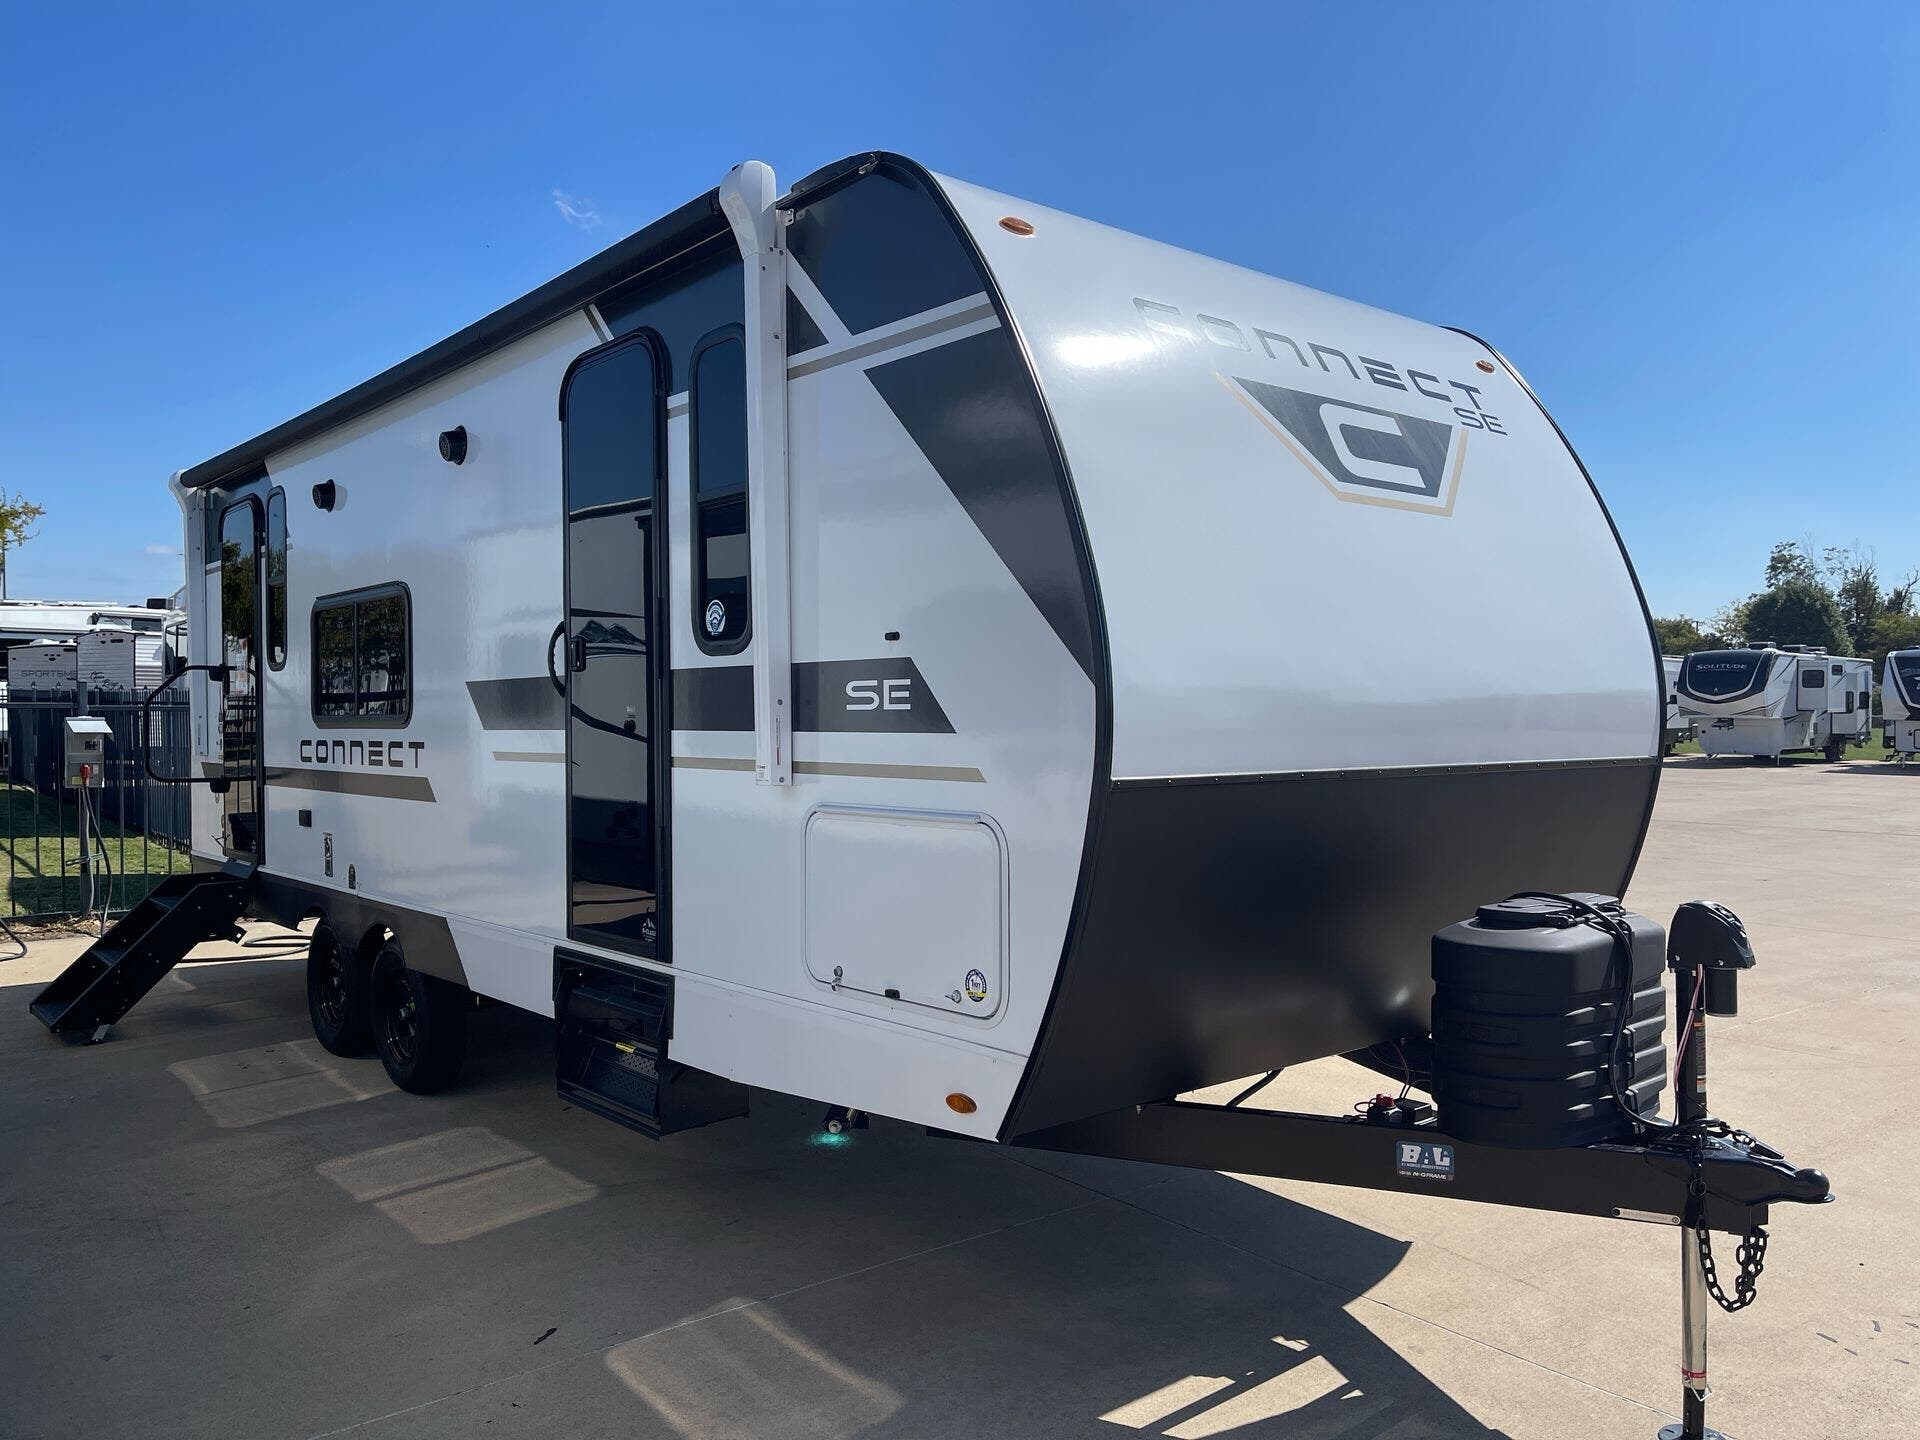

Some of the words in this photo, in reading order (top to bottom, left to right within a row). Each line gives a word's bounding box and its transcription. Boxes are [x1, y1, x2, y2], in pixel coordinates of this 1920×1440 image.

[1131, 296, 1483, 411] CONNECT
[1453, 406, 1508, 436] SE
[1696, 663, 1747, 671] SOLITUDE
[845, 679, 911, 710] SE
[300, 739, 425, 769] CONNECT
